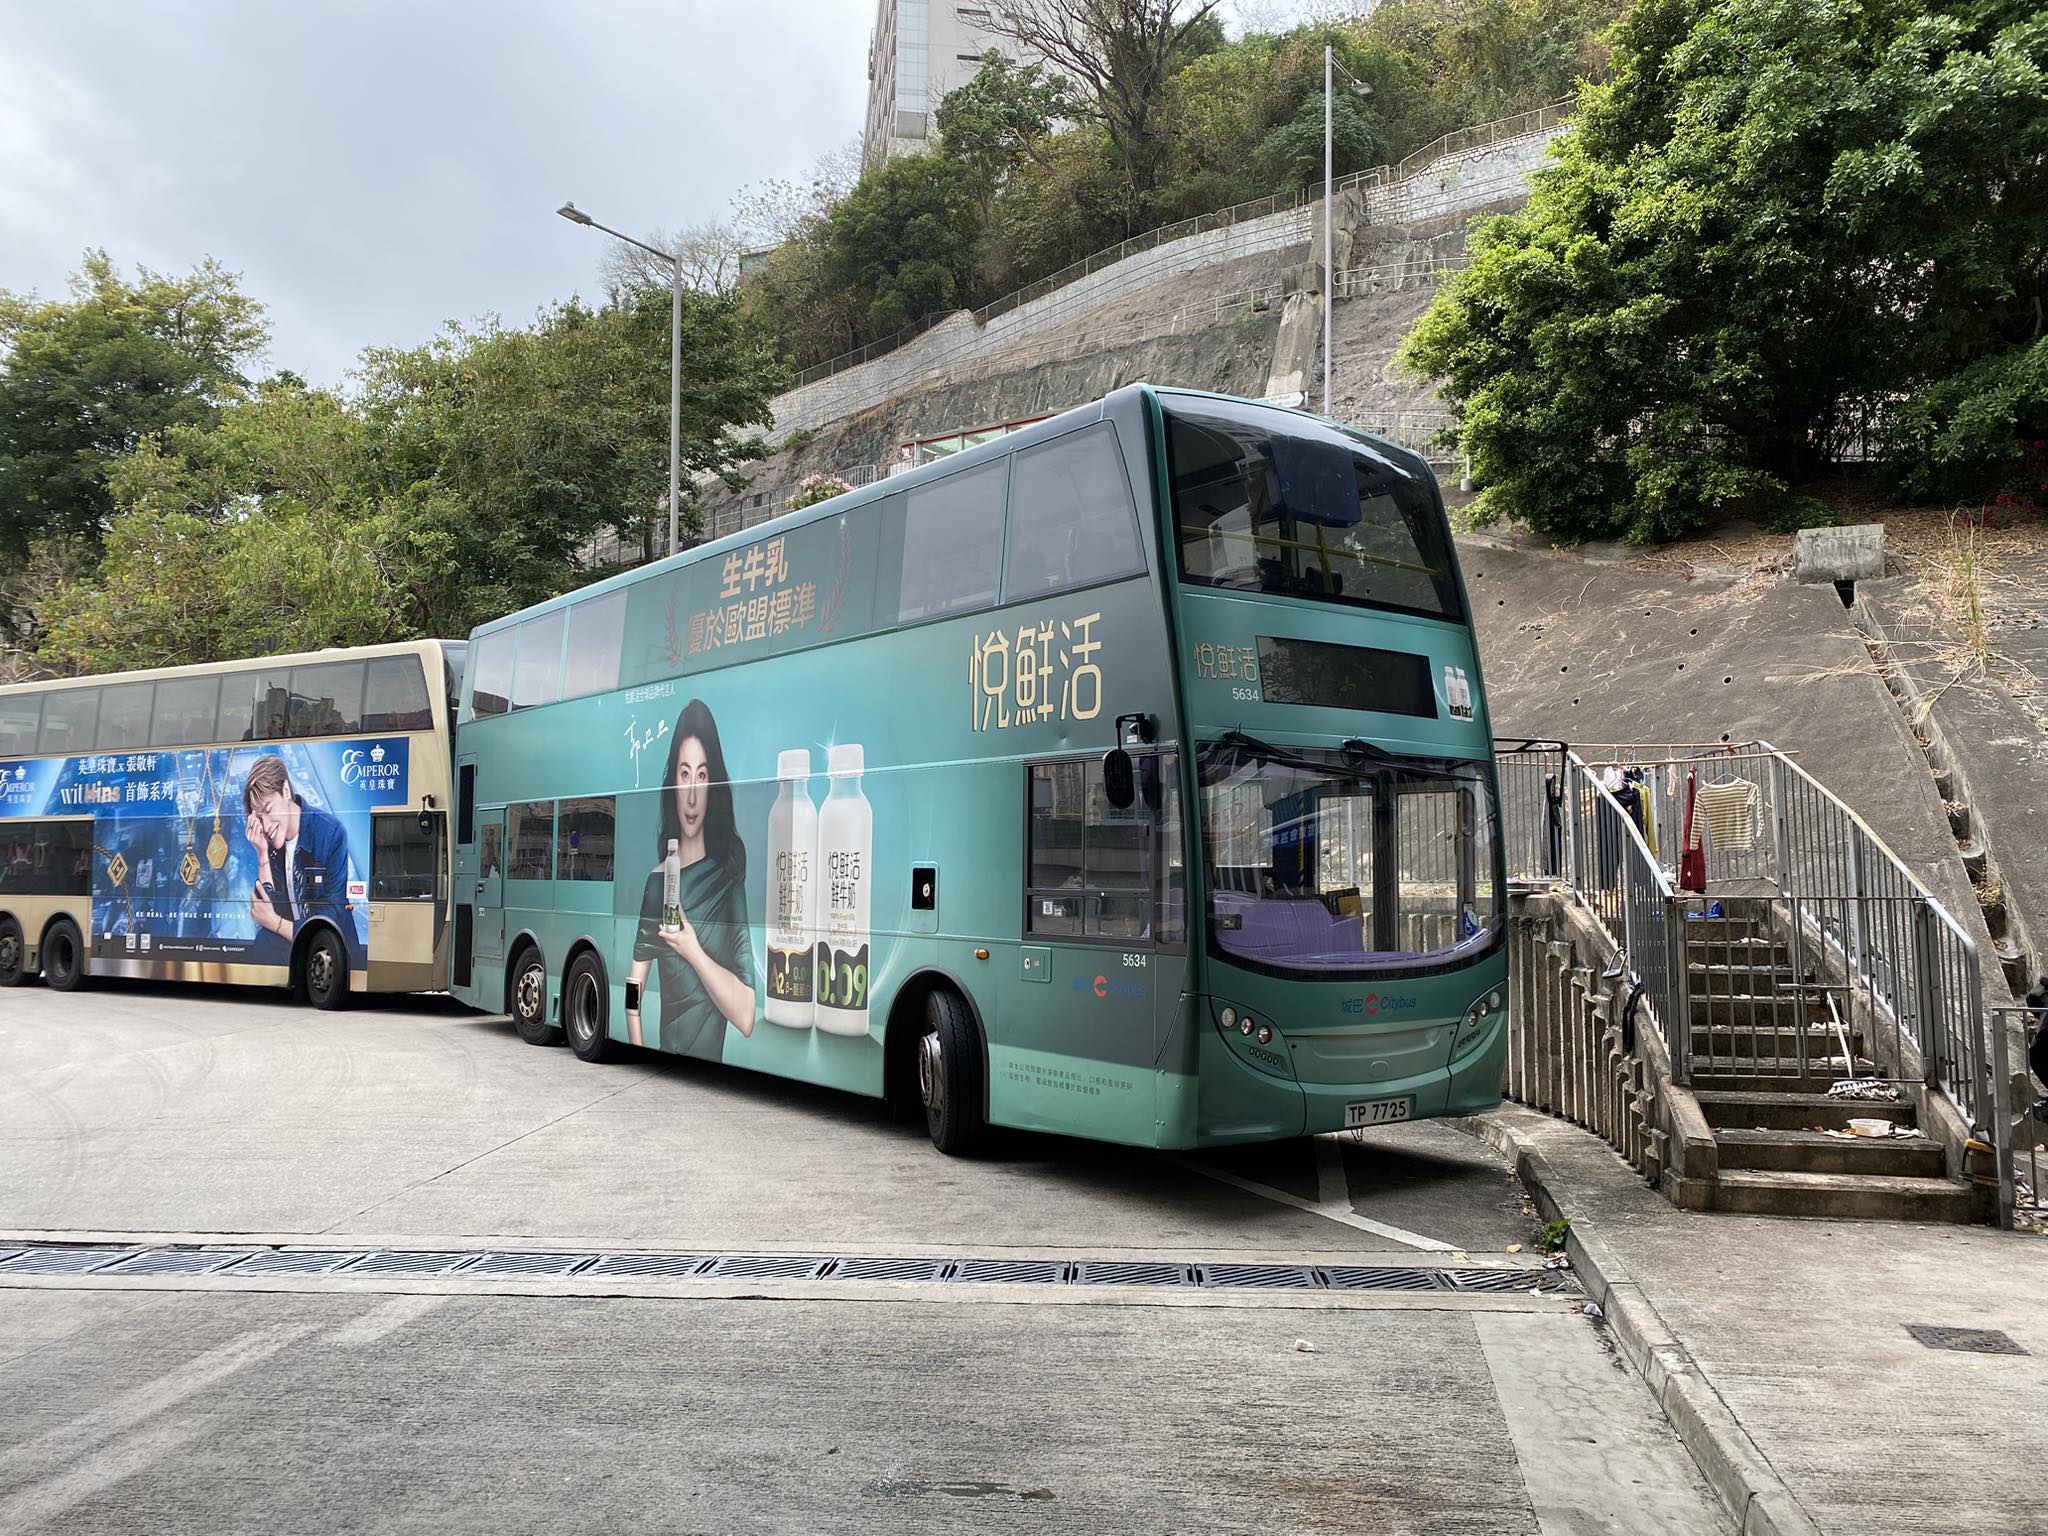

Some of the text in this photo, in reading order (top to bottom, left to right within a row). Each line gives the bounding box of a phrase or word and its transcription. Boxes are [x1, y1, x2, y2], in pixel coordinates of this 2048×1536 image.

[720, 537, 788, 599] 生牛乳
[687, 581, 816, 655] 優於歐盟標準
[1232, 687, 1259, 701] 5634
[125, 780, 174, 802] 首飾系列
[360, 778, 395, 790] 英皇珠寶
[1122, 953, 1146, 967] 5634
[818, 960, 867, 1007] 0.09
[1381, 996, 1417, 1011] Citybus
[1349, 1101, 1406, 1123] TP 7725
